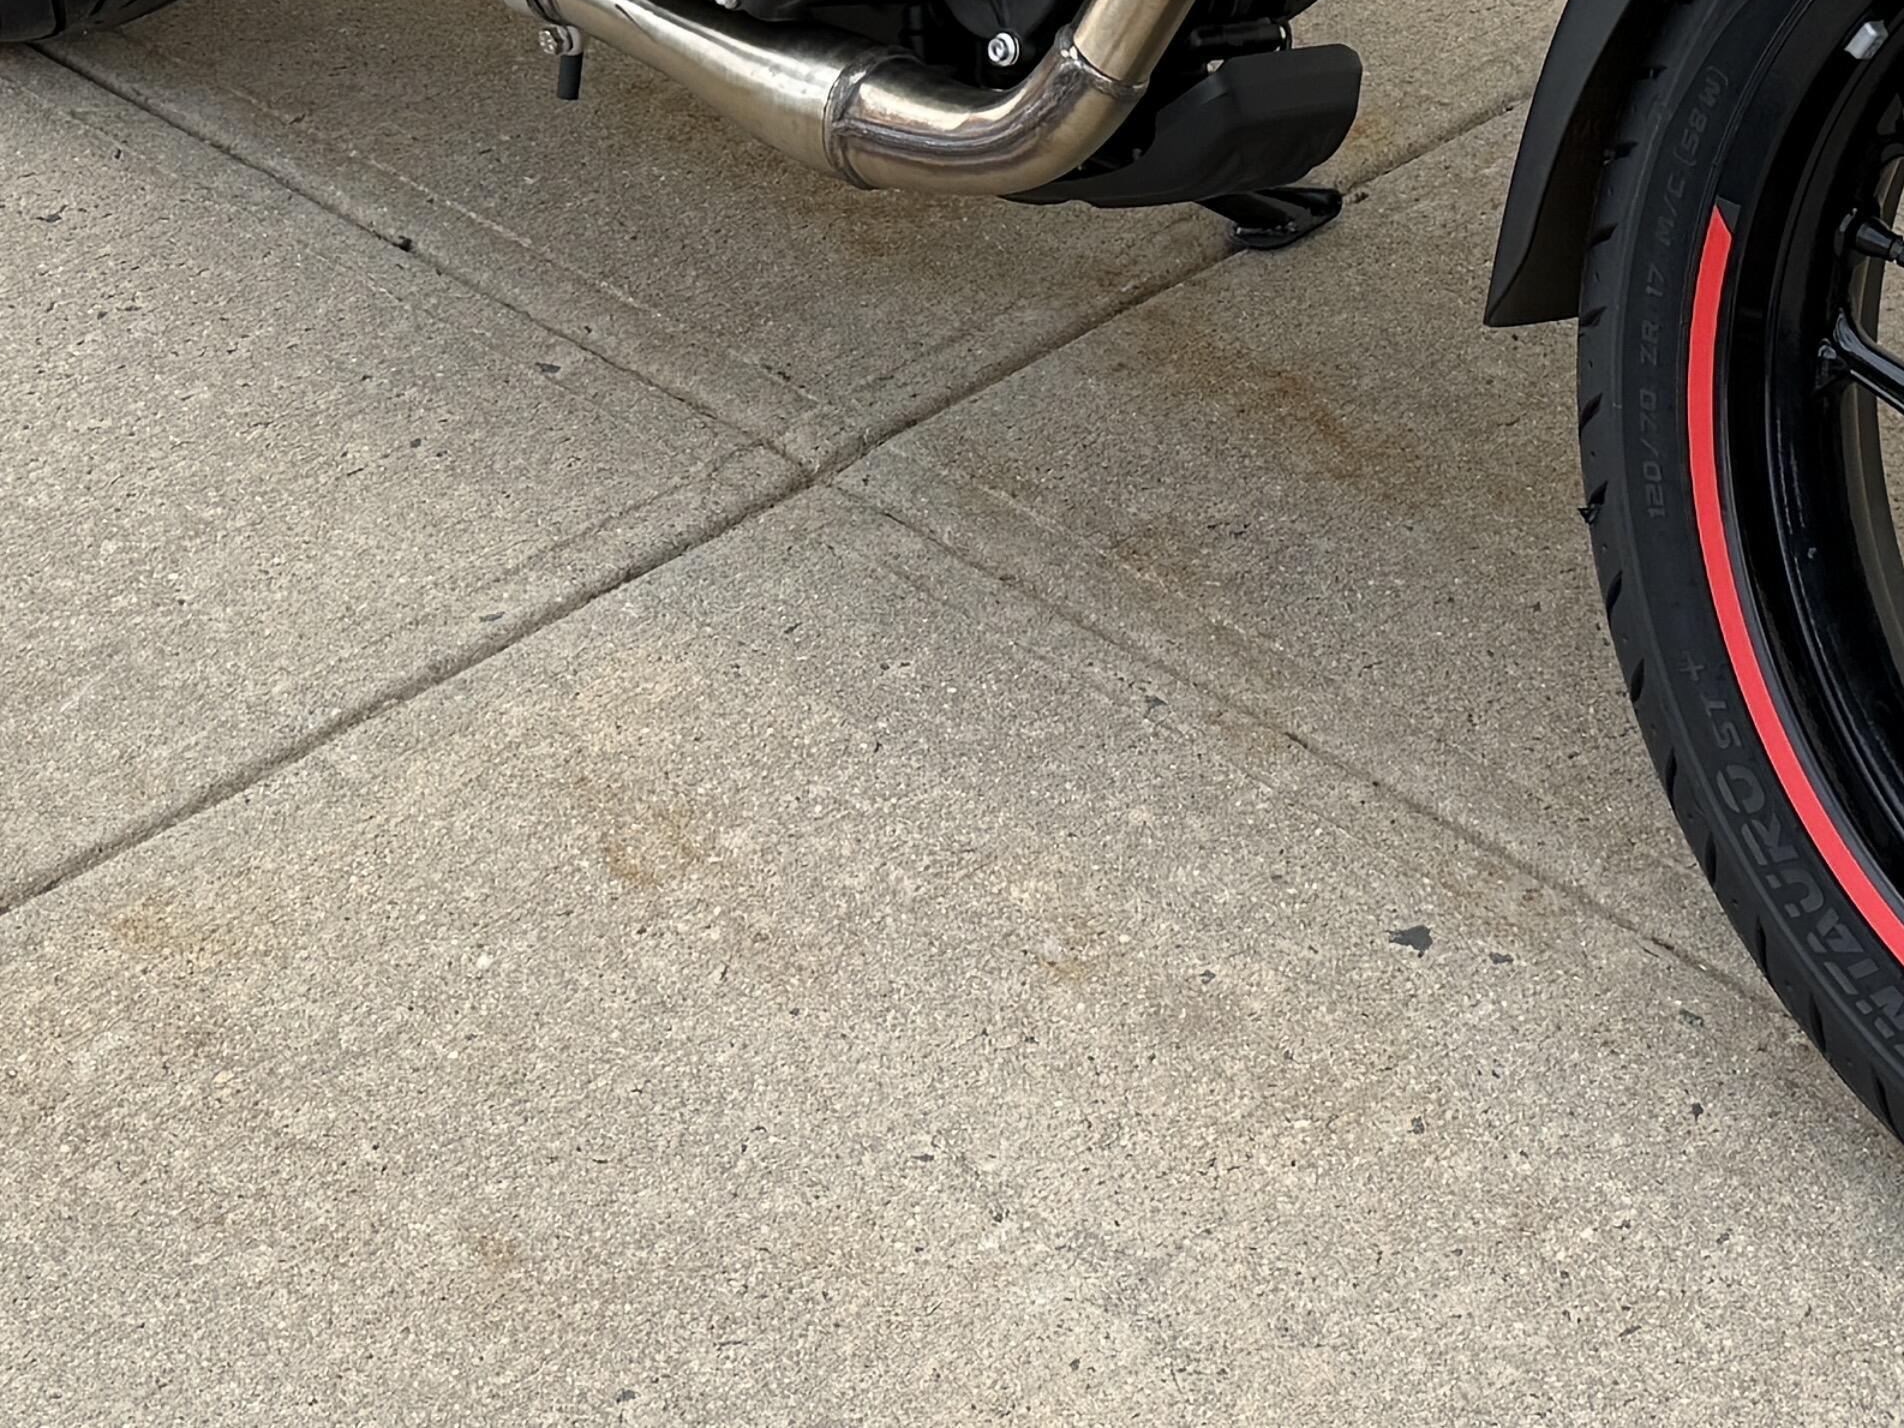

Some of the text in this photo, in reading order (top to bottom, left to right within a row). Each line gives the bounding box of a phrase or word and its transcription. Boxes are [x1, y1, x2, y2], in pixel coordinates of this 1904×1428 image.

[1655, 170, 1687, 248] M/C
[1645, 262, 1666, 298] 17
[1639, 319, 1659, 368] ZR
[1639, 388, 1666, 521] 120/70
